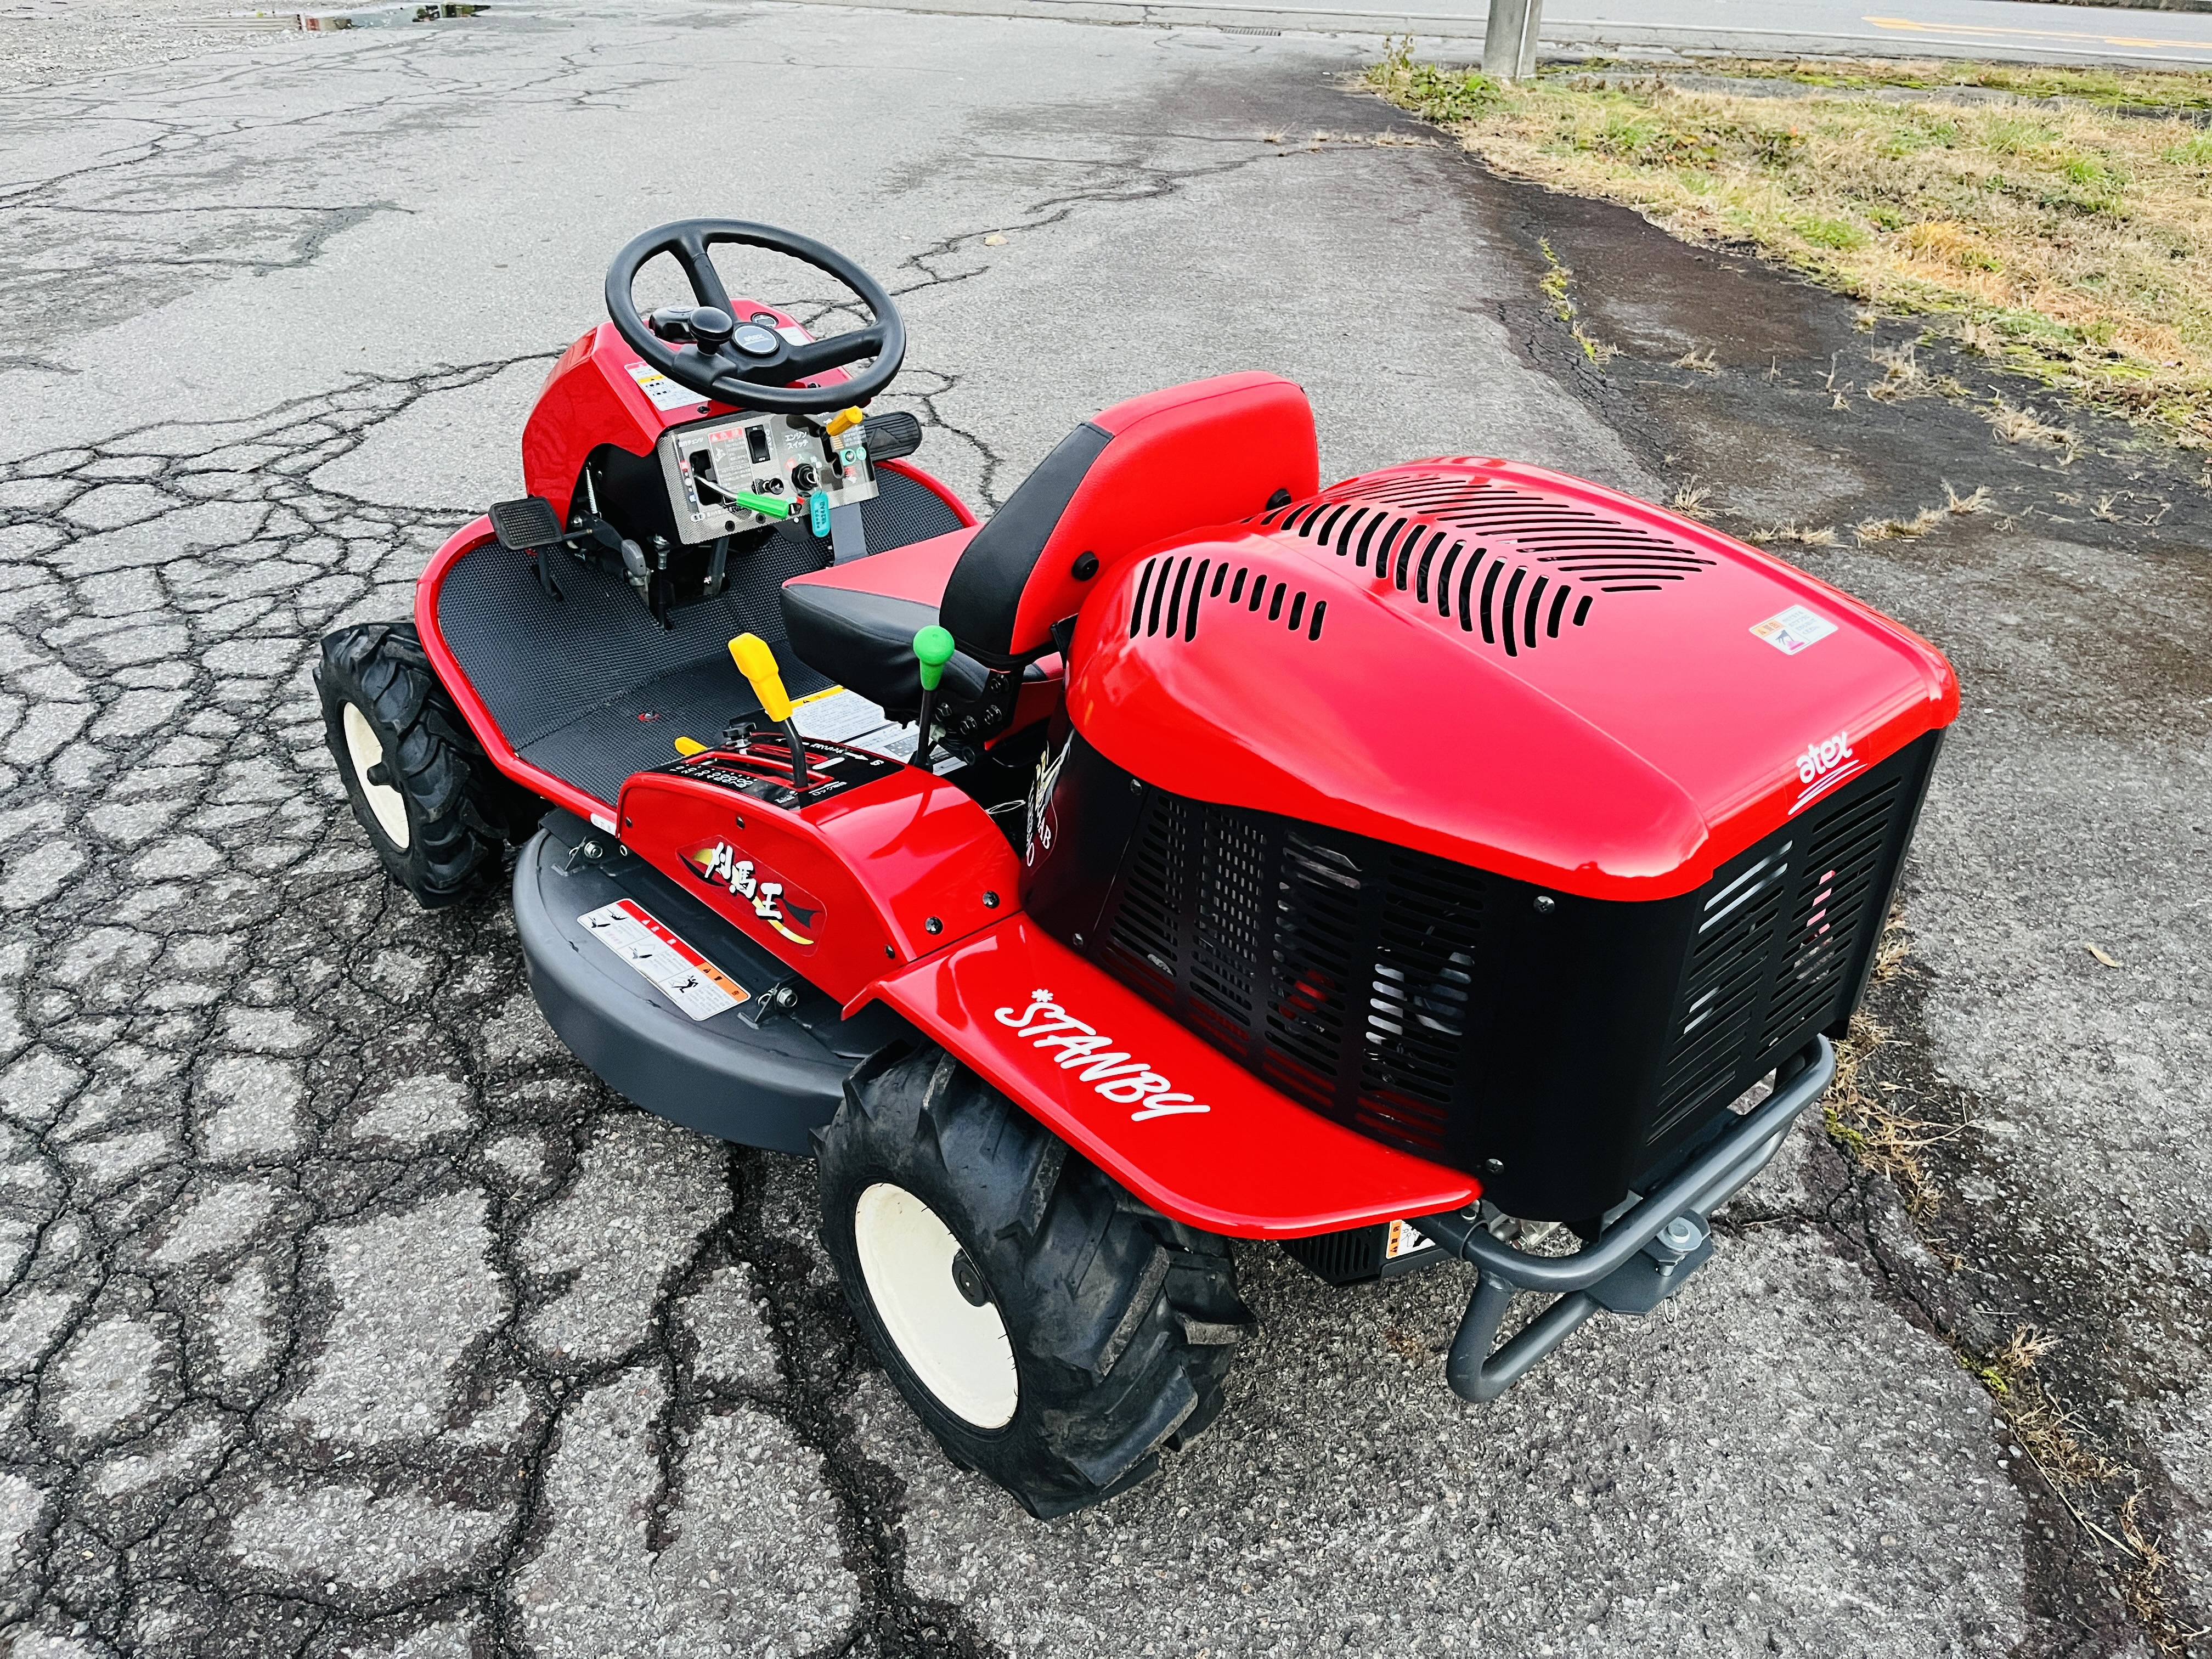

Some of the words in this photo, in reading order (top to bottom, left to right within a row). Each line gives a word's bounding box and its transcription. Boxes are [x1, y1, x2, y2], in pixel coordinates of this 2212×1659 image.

[785, 431, 808, 442] エンジン
[787, 439, 809, 450] スイッチ
[1796, 731, 1853, 784] atex
[704, 842, 783, 919] 刈馬王
